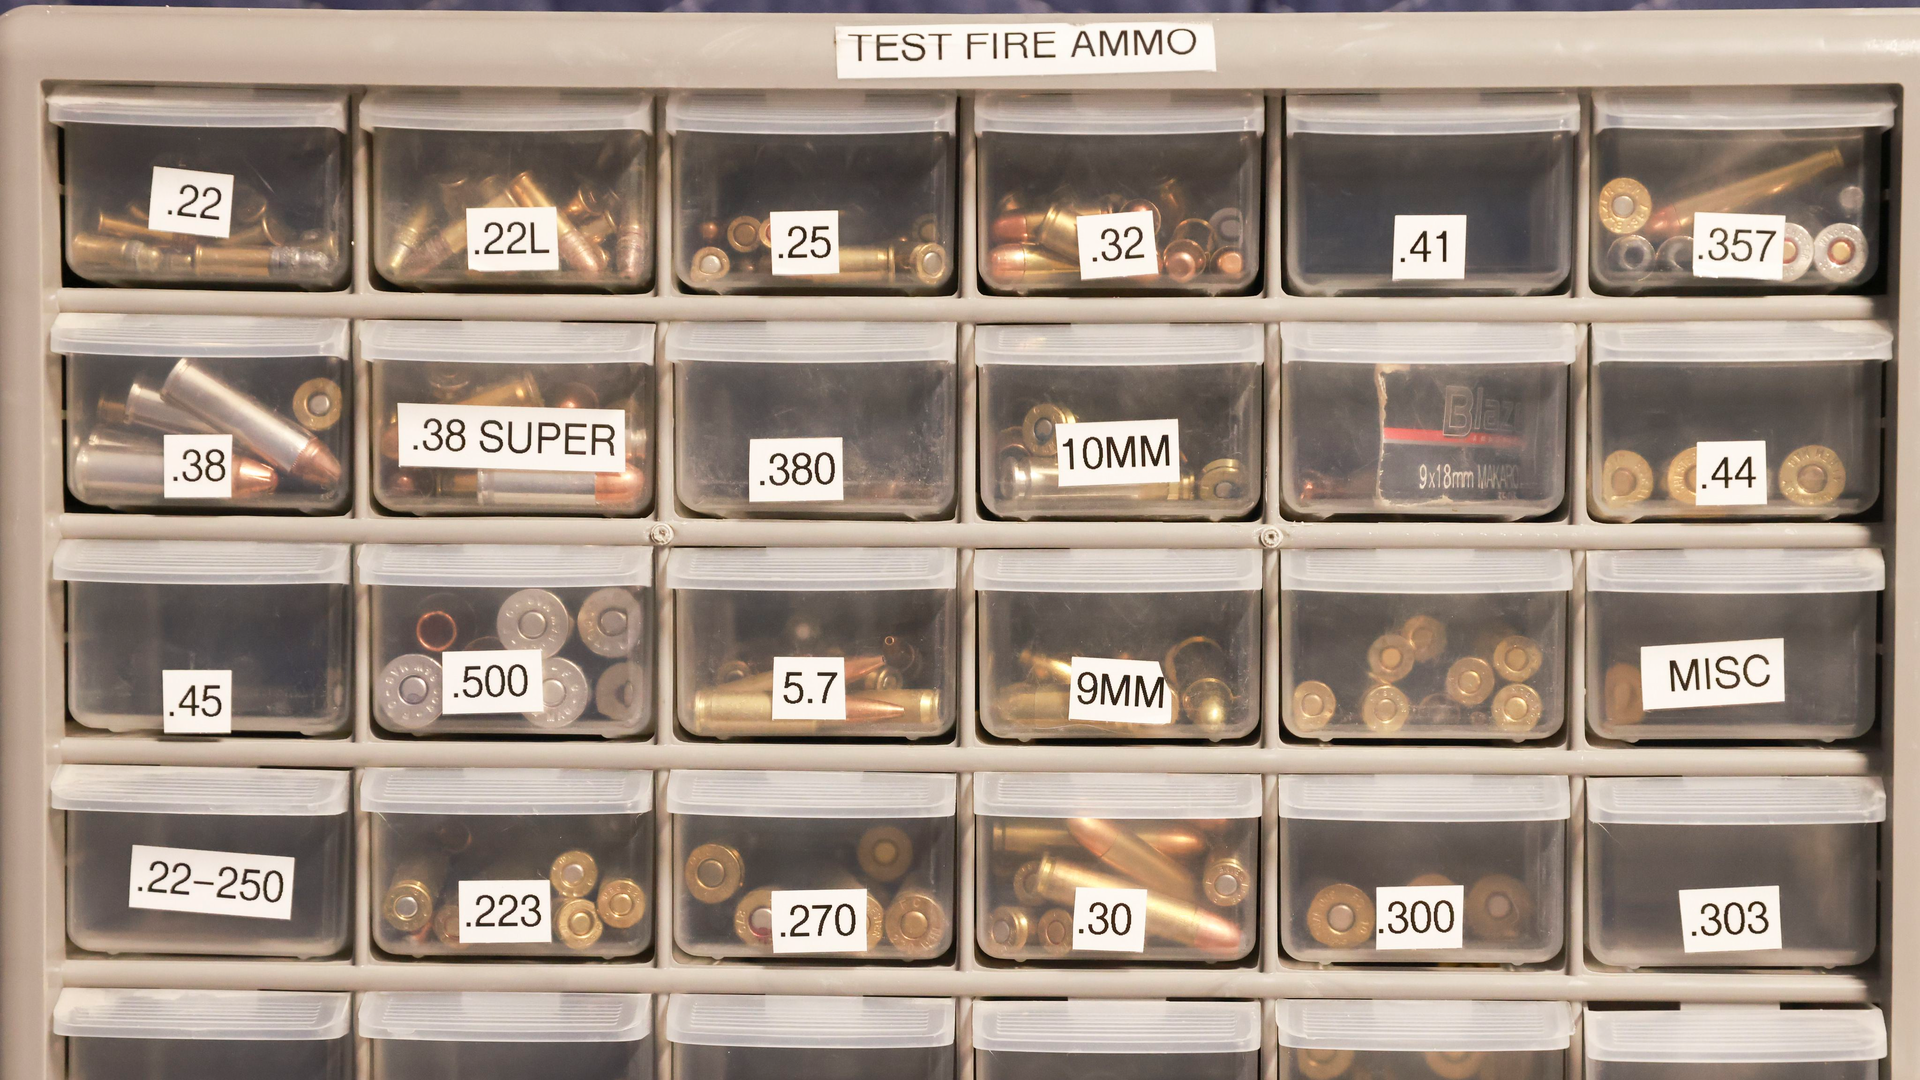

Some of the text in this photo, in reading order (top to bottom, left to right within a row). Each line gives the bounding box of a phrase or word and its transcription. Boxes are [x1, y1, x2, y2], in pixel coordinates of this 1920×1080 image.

[848, 28, 1197, 62] TEST FIRE AMMO
[167, 184, 222, 221] .22
[474, 221, 550, 255] .22L
[778, 225, 832, 259] .25
[1092, 226, 1145, 263] .32
[1400, 230, 1447, 263] .41
[1698, 227, 1777, 262] .357
[413, 417, 616, 457] .38 SUPER
[1062, 434, 1170, 470] 10MM
[173, 448, 226, 483] .38
[759, 451, 836, 487] .380
[1418, 463, 1474, 490] 9x18mm
[1701, 456, 1757, 490] .44
[453, 663, 529, 699] .500
[783, 671, 838, 705] 5.7
[1077, 671, 1165, 709] 9MM
[1669, 653, 1771, 692] MISC
[169, 684, 222, 718] .45
[137, 860, 284, 904] .22-250
[466, 894, 542, 928] .223
[780, 903, 857, 938] .270
[1078, 901, 1132, 936] .30
[1378, 899, 1455, 935] .300
[1691, 900, 1770, 937] .303
